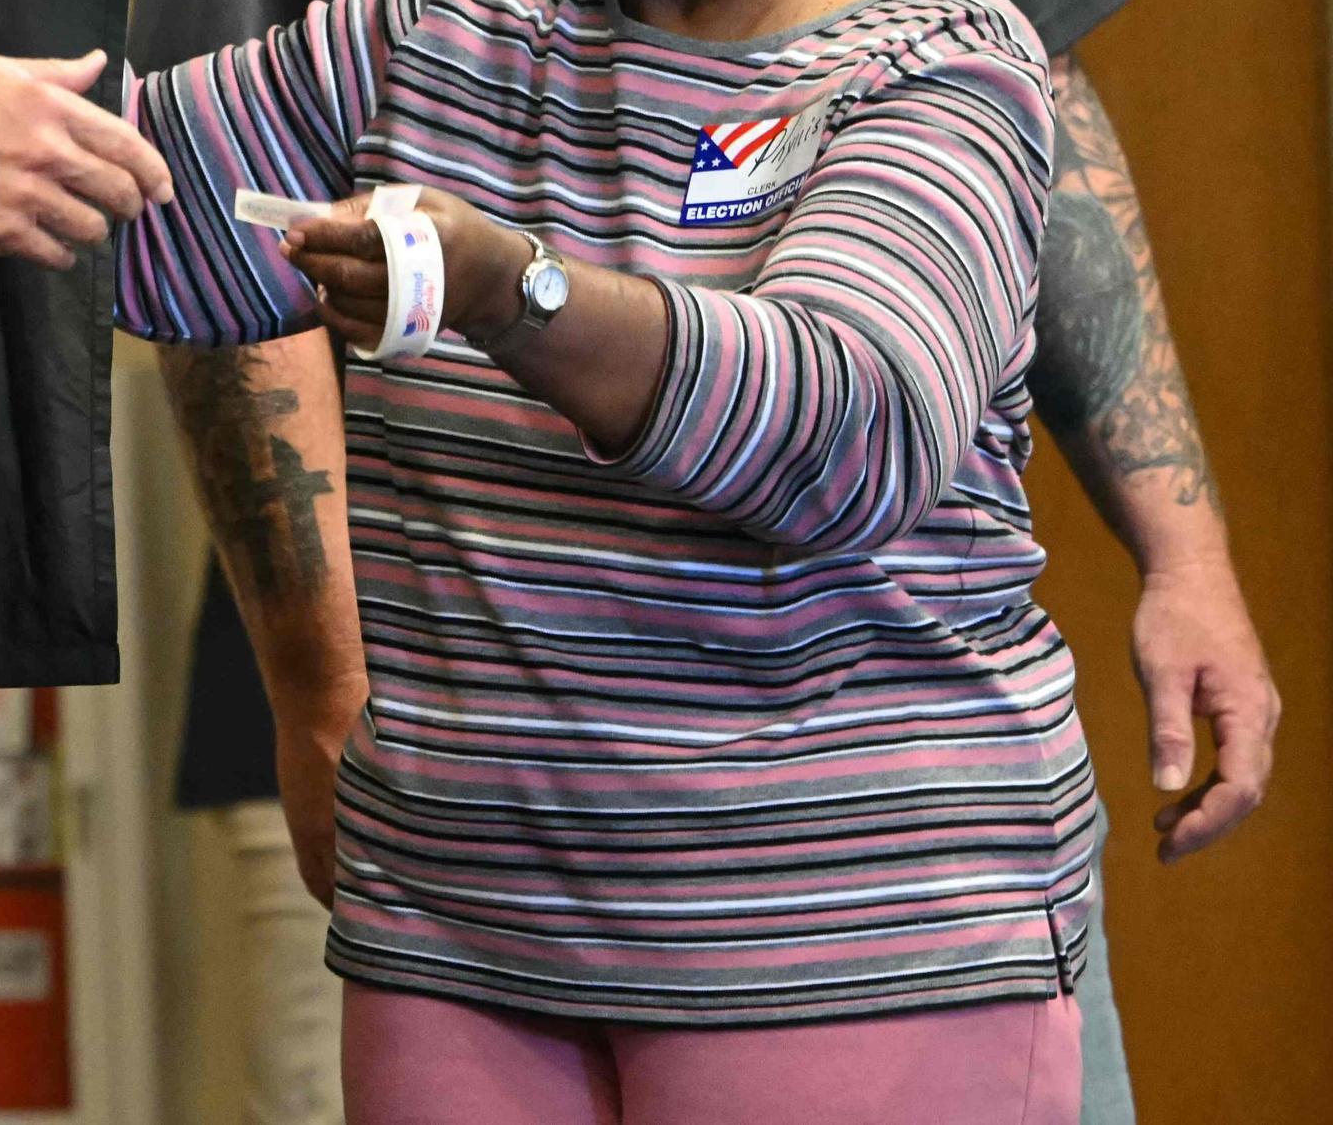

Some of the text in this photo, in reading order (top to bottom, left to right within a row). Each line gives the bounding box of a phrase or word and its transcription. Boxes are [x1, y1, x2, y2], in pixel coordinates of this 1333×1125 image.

[686, 175, 807, 221] ELECTION OFFICIA
[747, 181, 777, 196] CLERK
